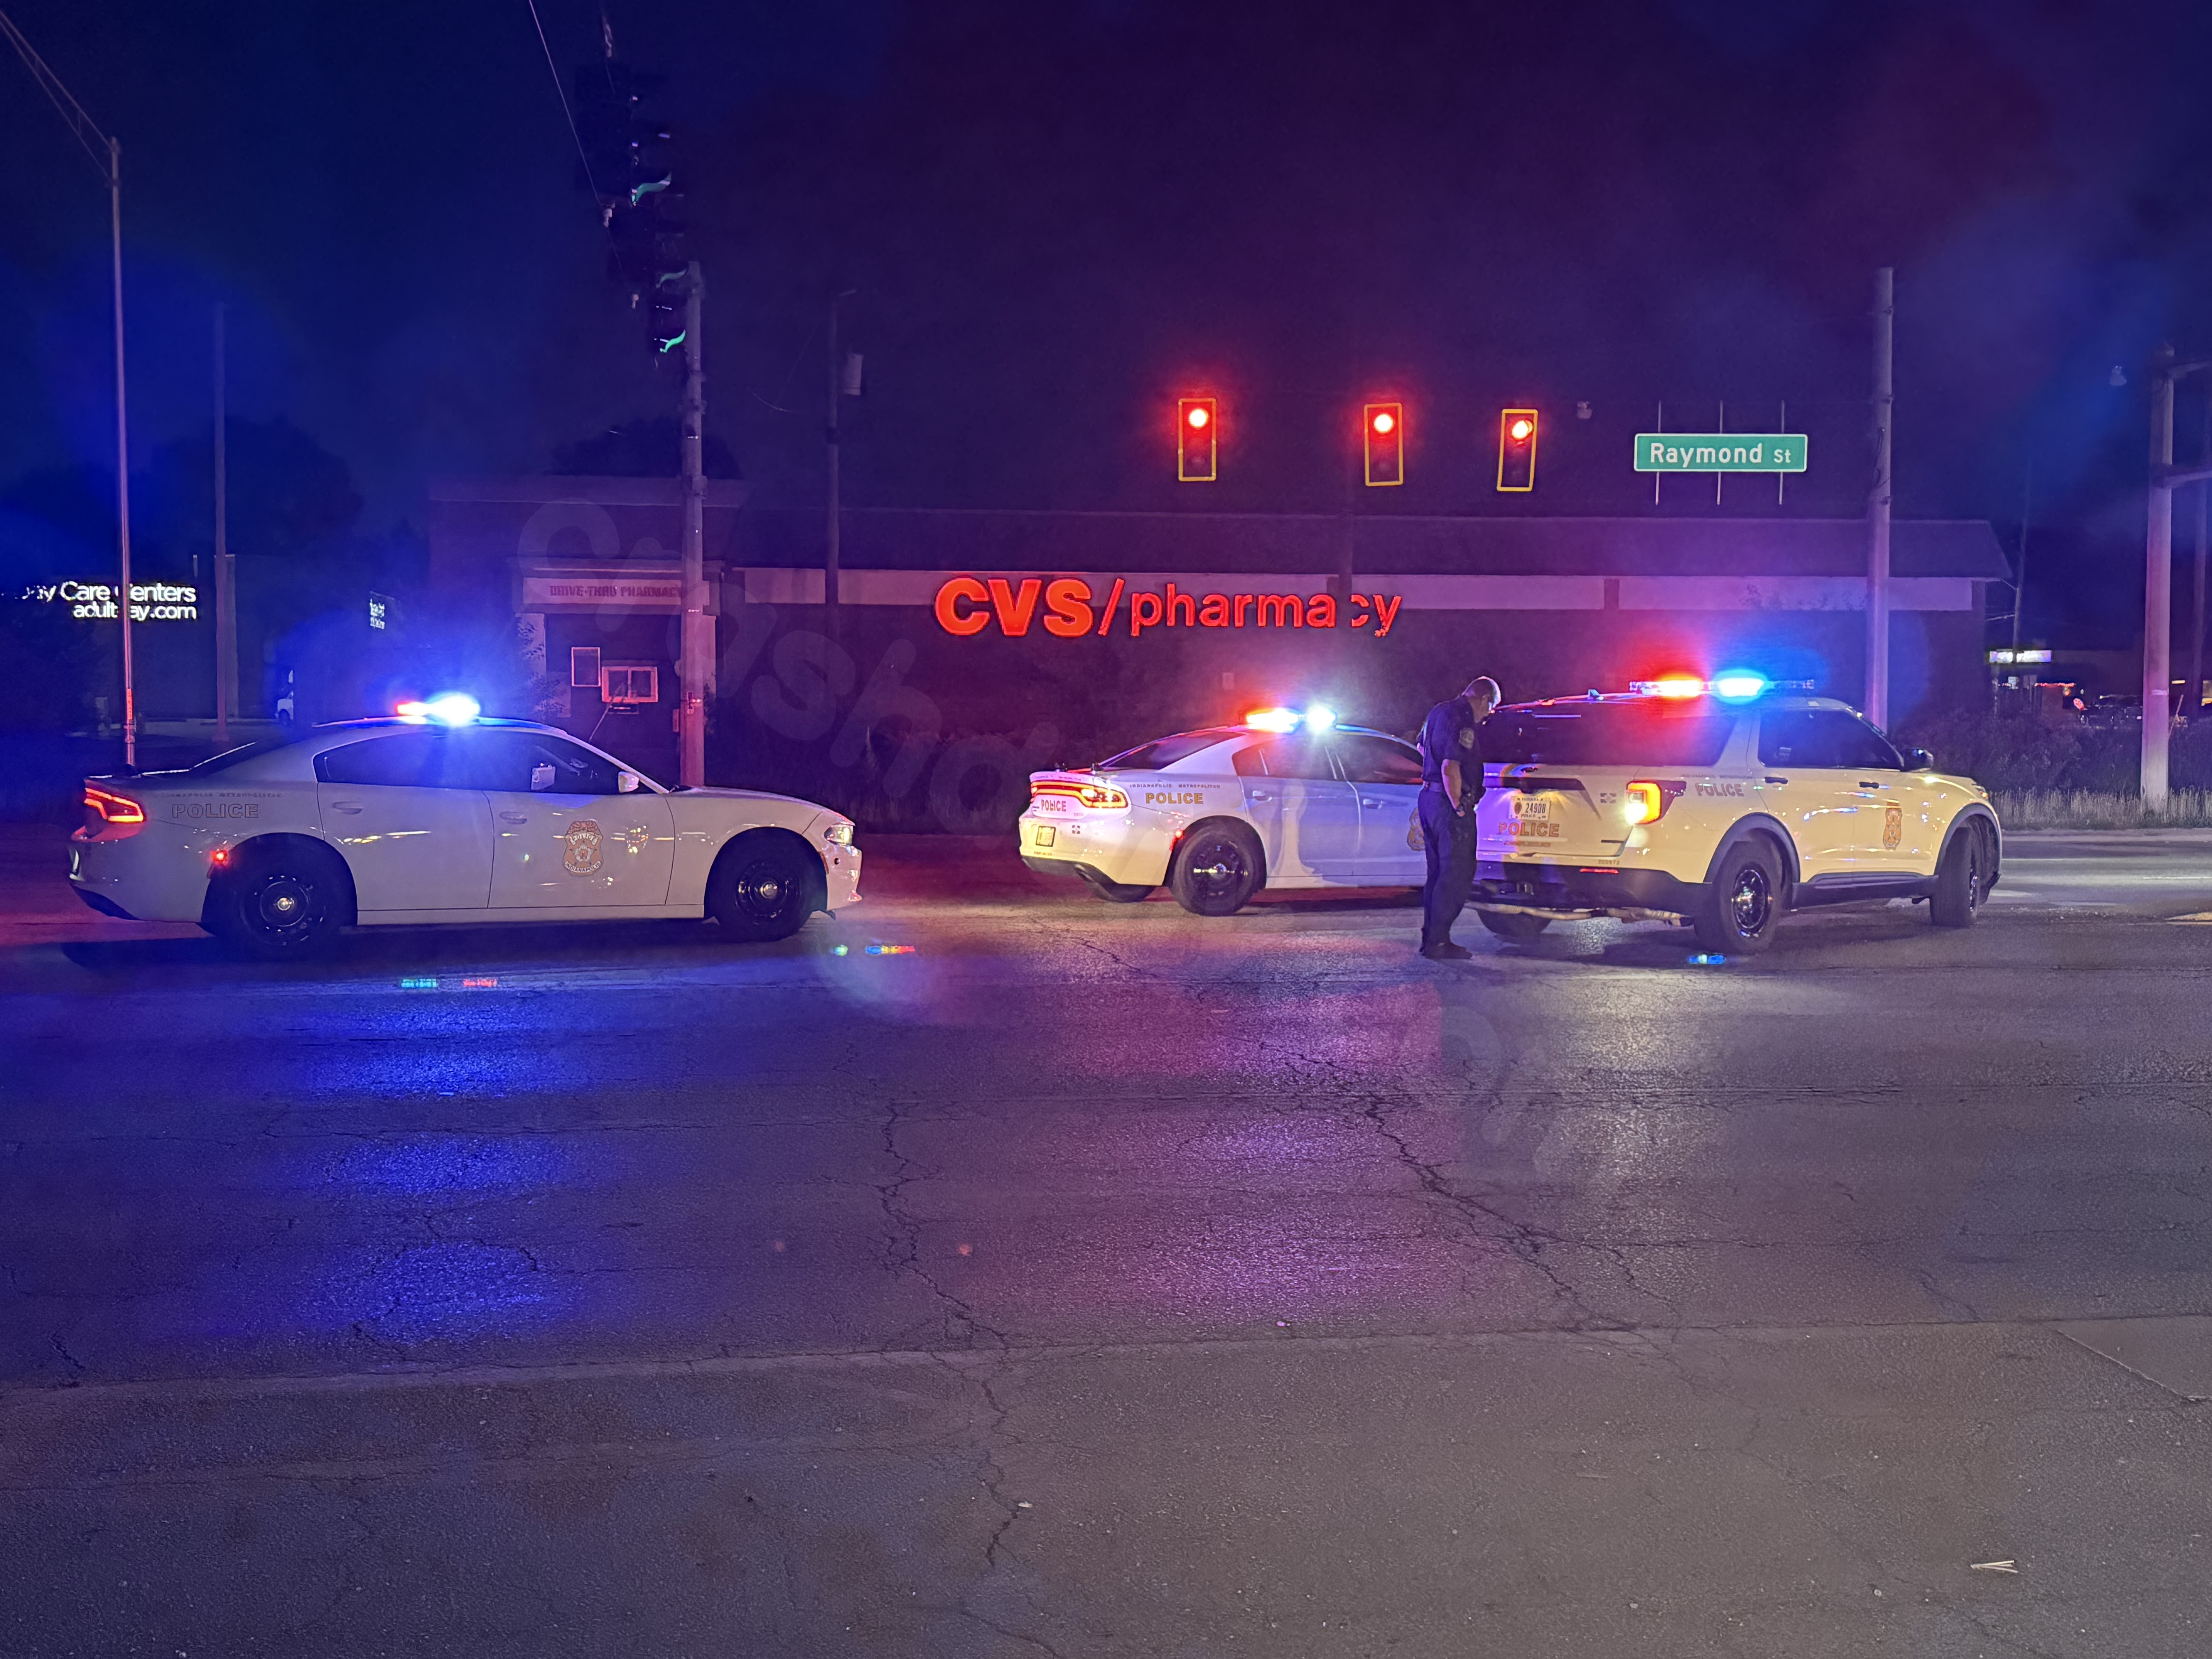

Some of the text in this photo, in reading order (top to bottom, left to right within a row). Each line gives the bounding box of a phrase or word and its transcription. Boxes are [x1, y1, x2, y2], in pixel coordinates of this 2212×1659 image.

[1650, 443, 1791, 468] Raymond St
[60, 581, 111, 601] Care
[73, 601, 196, 621] adultay.com
[1695, 783, 1744, 797] POLICE
[1041, 799, 1066, 812] POLICE
[1145, 792, 1204, 804] POLICE
[172, 803, 259, 818] POLICE
[1498, 822, 1560, 837] POLICE
